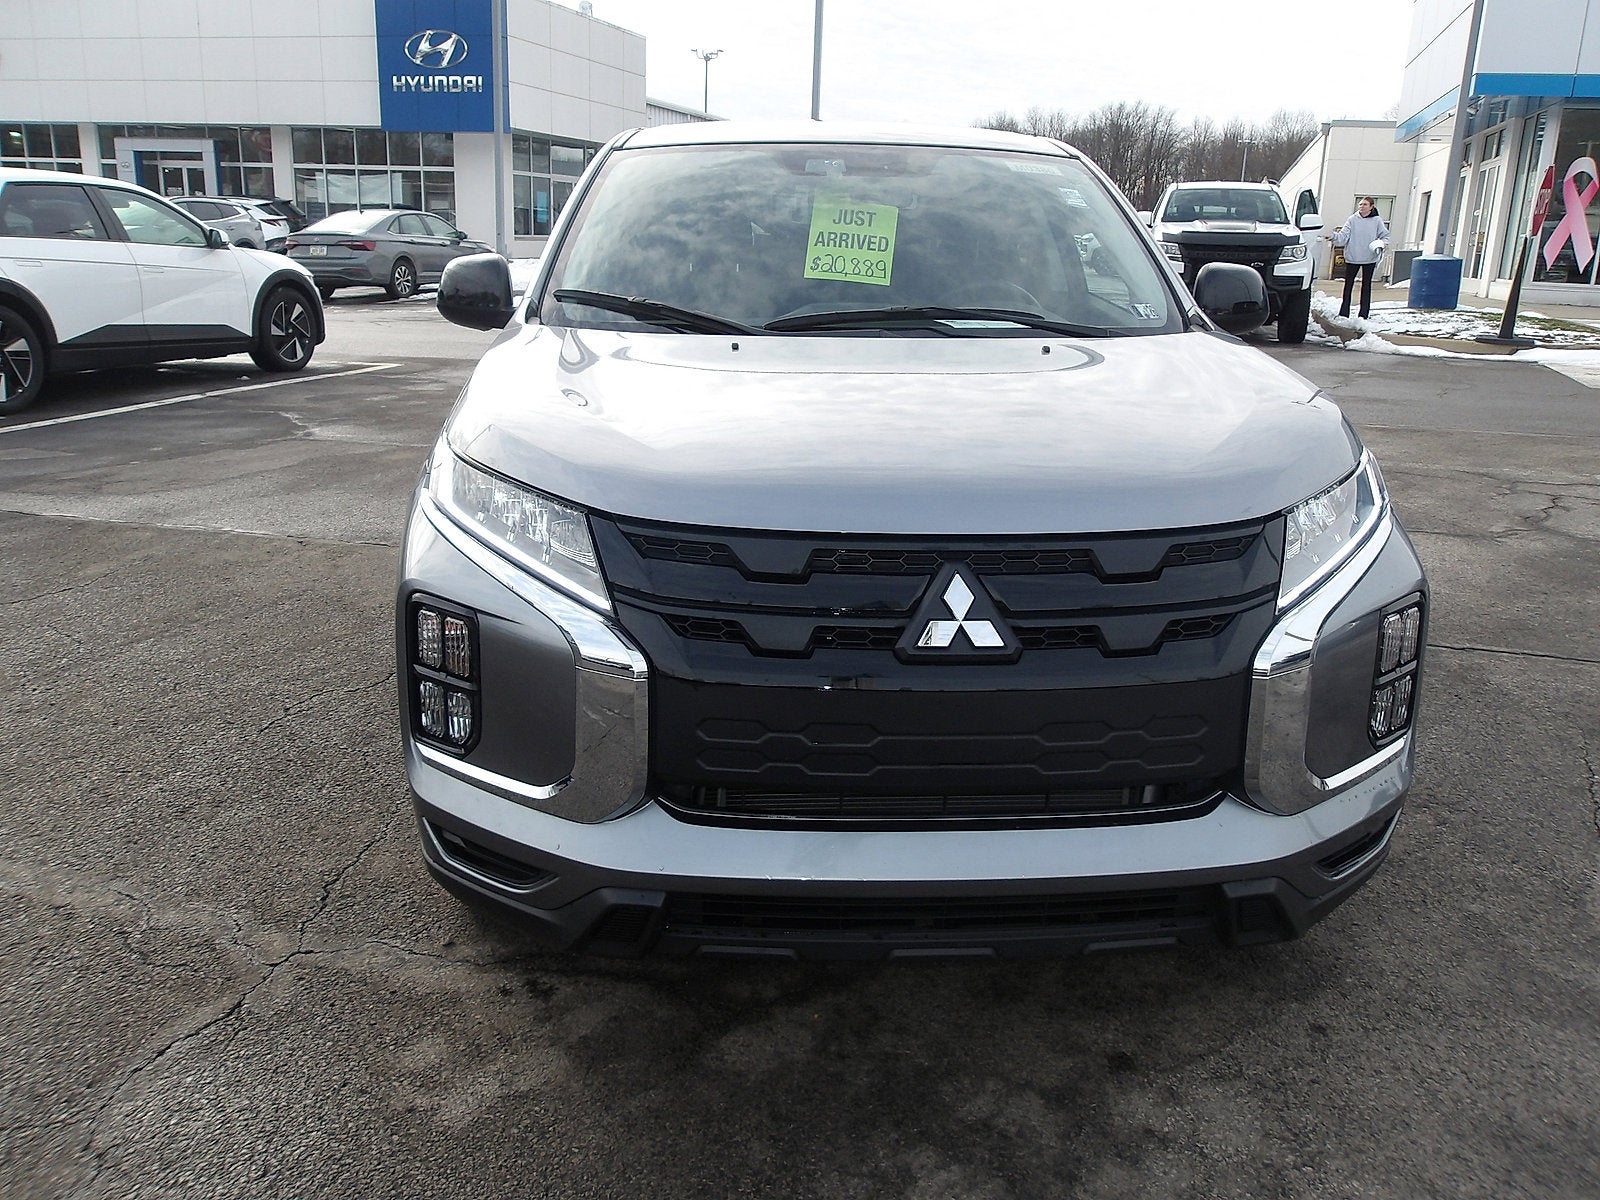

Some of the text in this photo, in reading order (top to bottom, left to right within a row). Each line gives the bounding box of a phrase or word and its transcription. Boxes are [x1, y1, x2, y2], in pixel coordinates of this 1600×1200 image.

[392, 75, 483, 93] HYUNDAI
[832, 208, 877, 228] JUST
[813, 231, 890, 253] ARRIVED
[810, 253, 888, 279] $20,889
